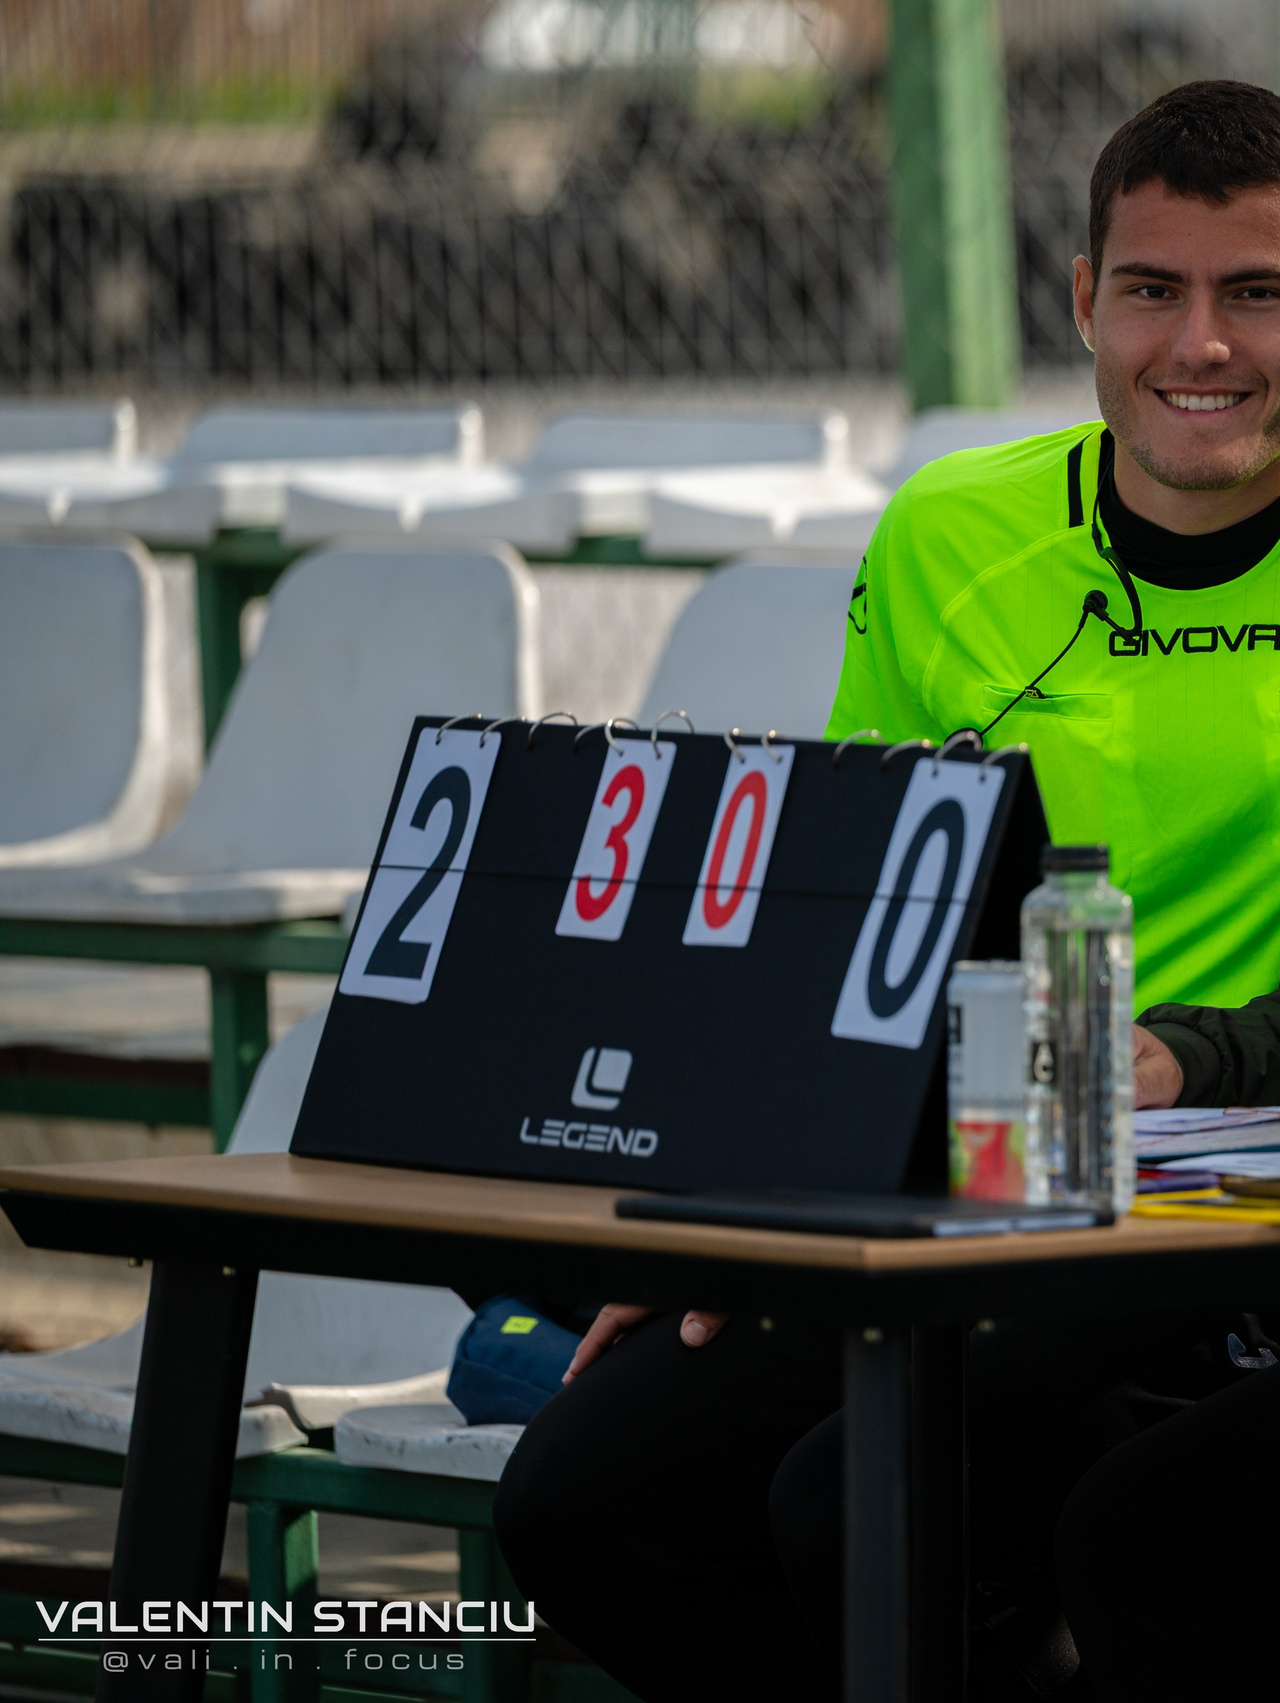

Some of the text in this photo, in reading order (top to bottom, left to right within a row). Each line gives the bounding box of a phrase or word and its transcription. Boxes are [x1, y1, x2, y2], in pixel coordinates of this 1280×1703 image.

[362, 765, 966, 1020] 2 3 0 0
[519, 1116, 659, 1158] LEGEND
